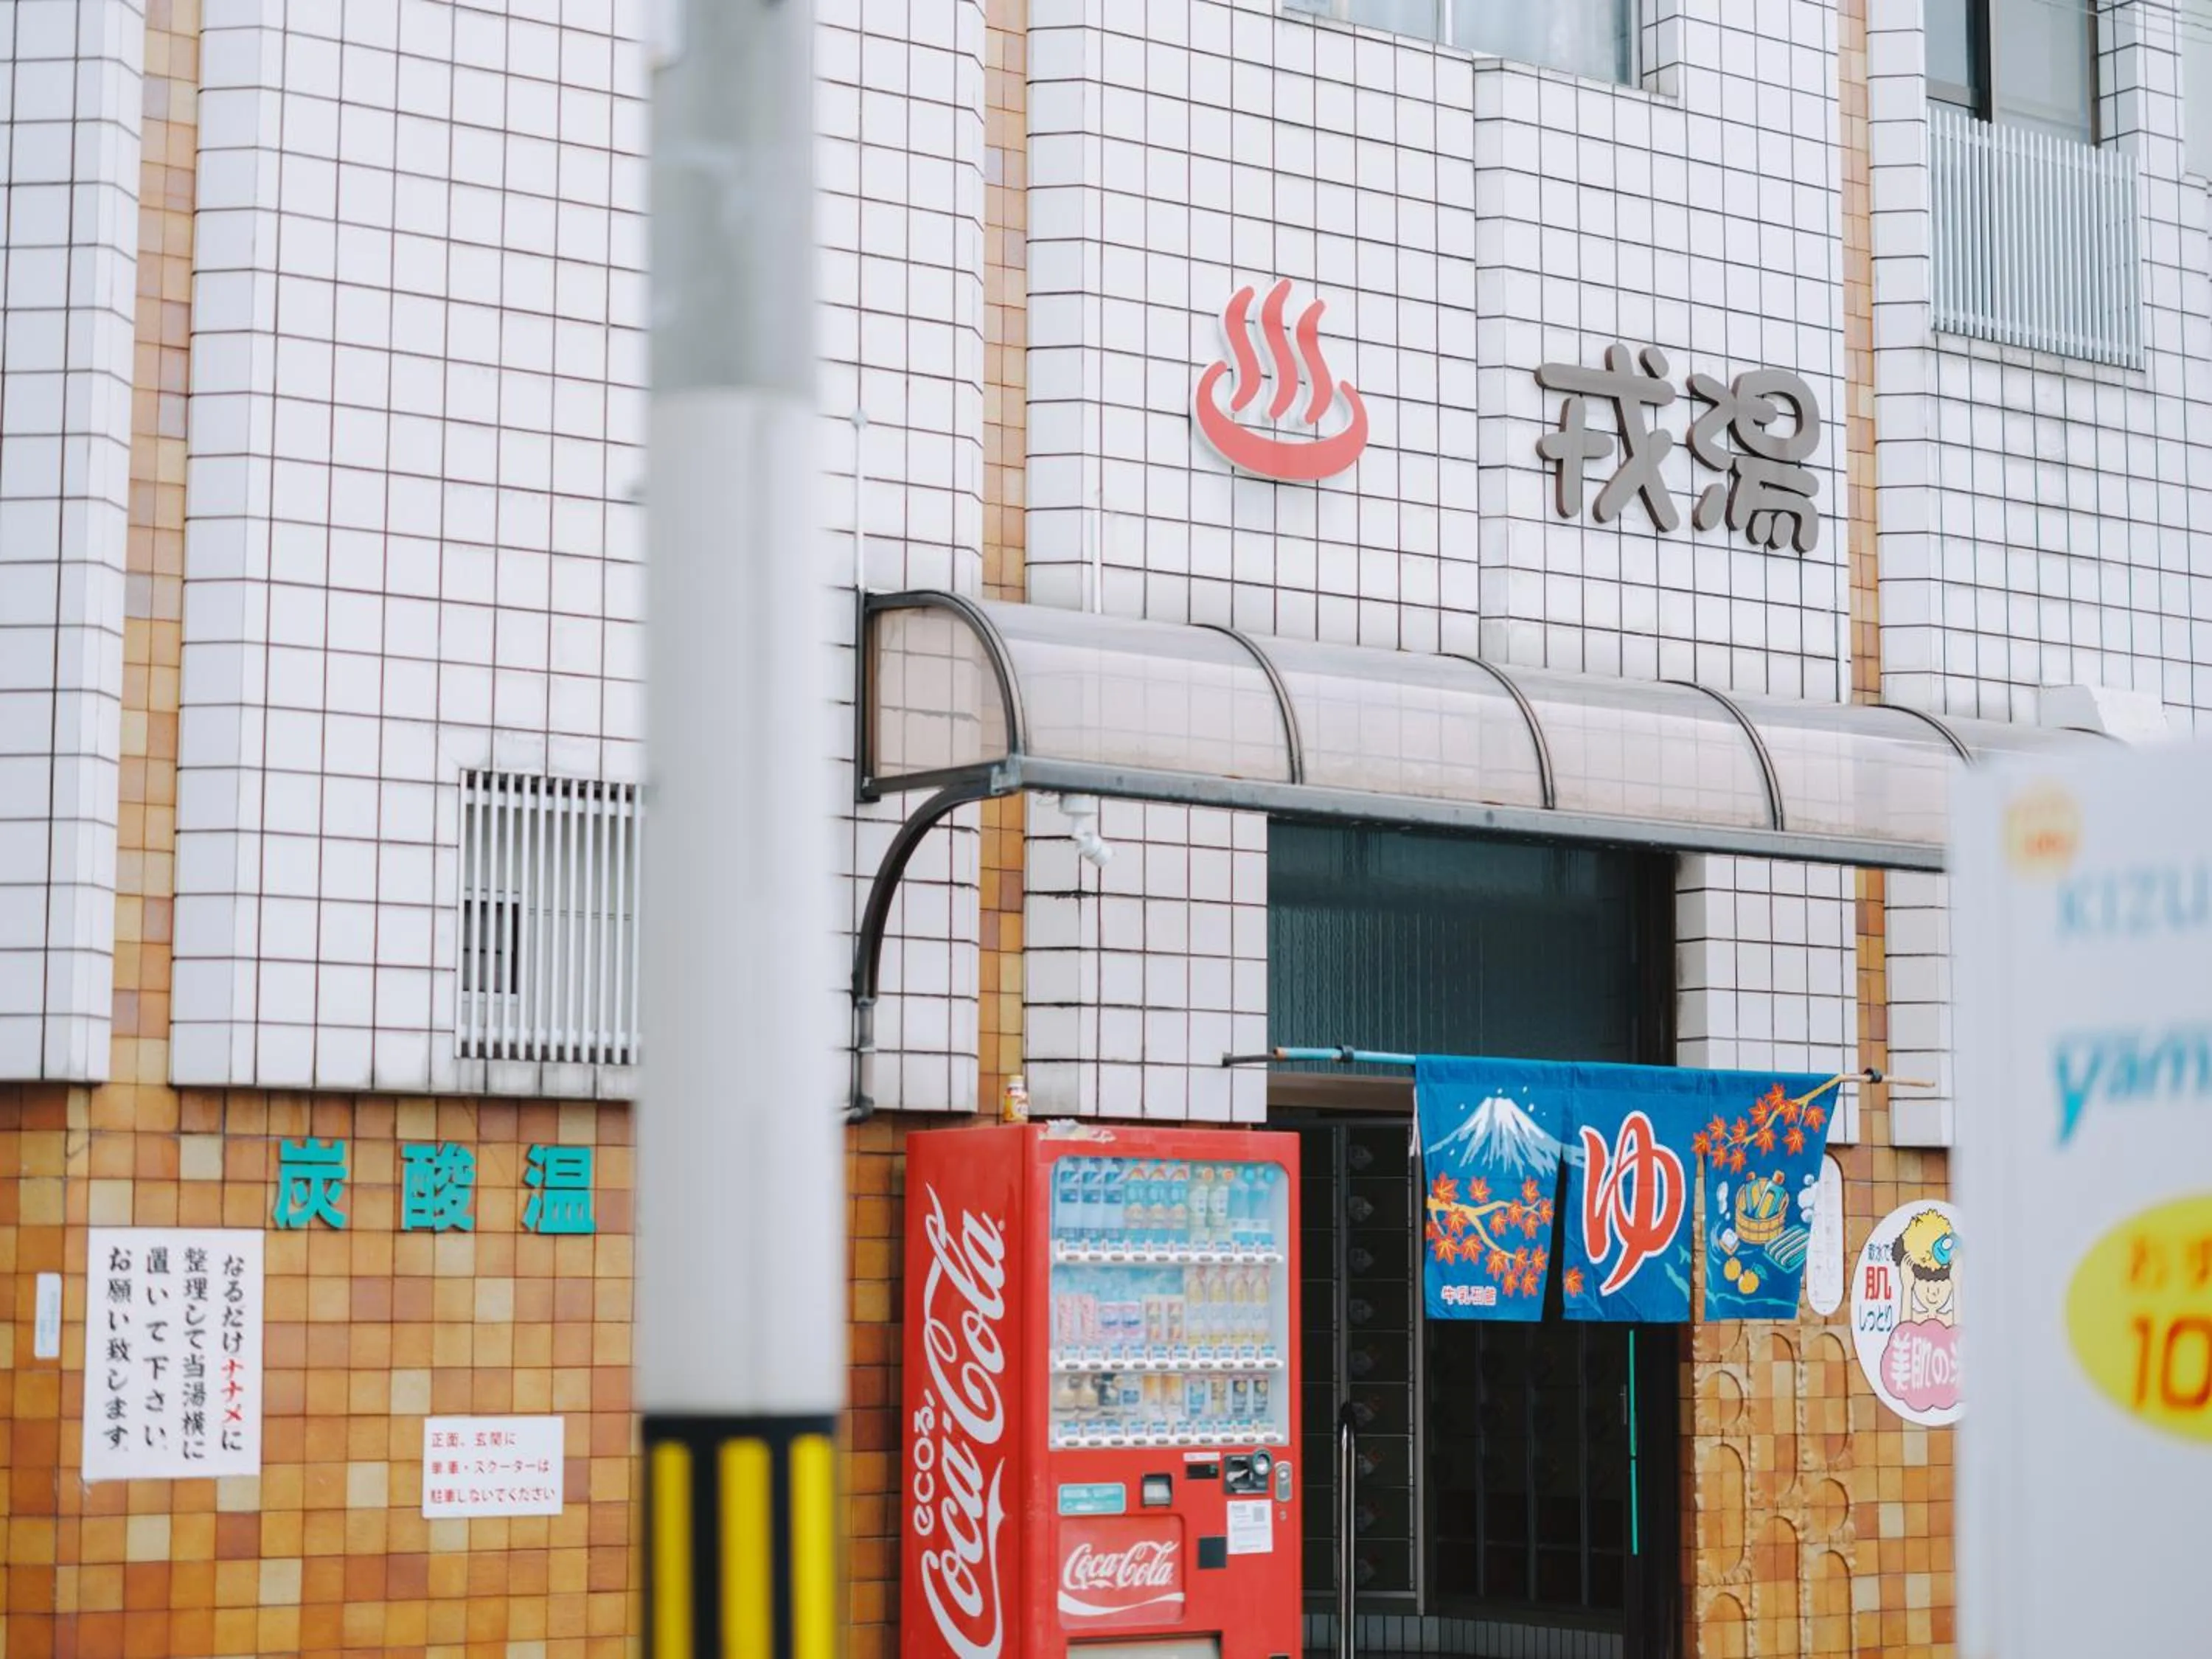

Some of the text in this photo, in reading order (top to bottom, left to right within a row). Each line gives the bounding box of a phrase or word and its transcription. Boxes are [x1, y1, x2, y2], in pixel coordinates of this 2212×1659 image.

[1534, 344, 1820, 552] 戎湯
[1579, 1110, 1686, 1296] ゆ
[1865, 1265, 1892, 1300] 肌
[182, 1247, 208, 1461] 整理して当湯横に
[220, 1254, 245, 1451] なるだけナナメに
[1859, 1304, 1893, 1332] しっとり
[1890, 1330, 1958, 1391] 美肌の
[922, 1182, 1005, 1659] Coca-Cola
[1062, 1540, 1180, 1590] Coca-Cola
